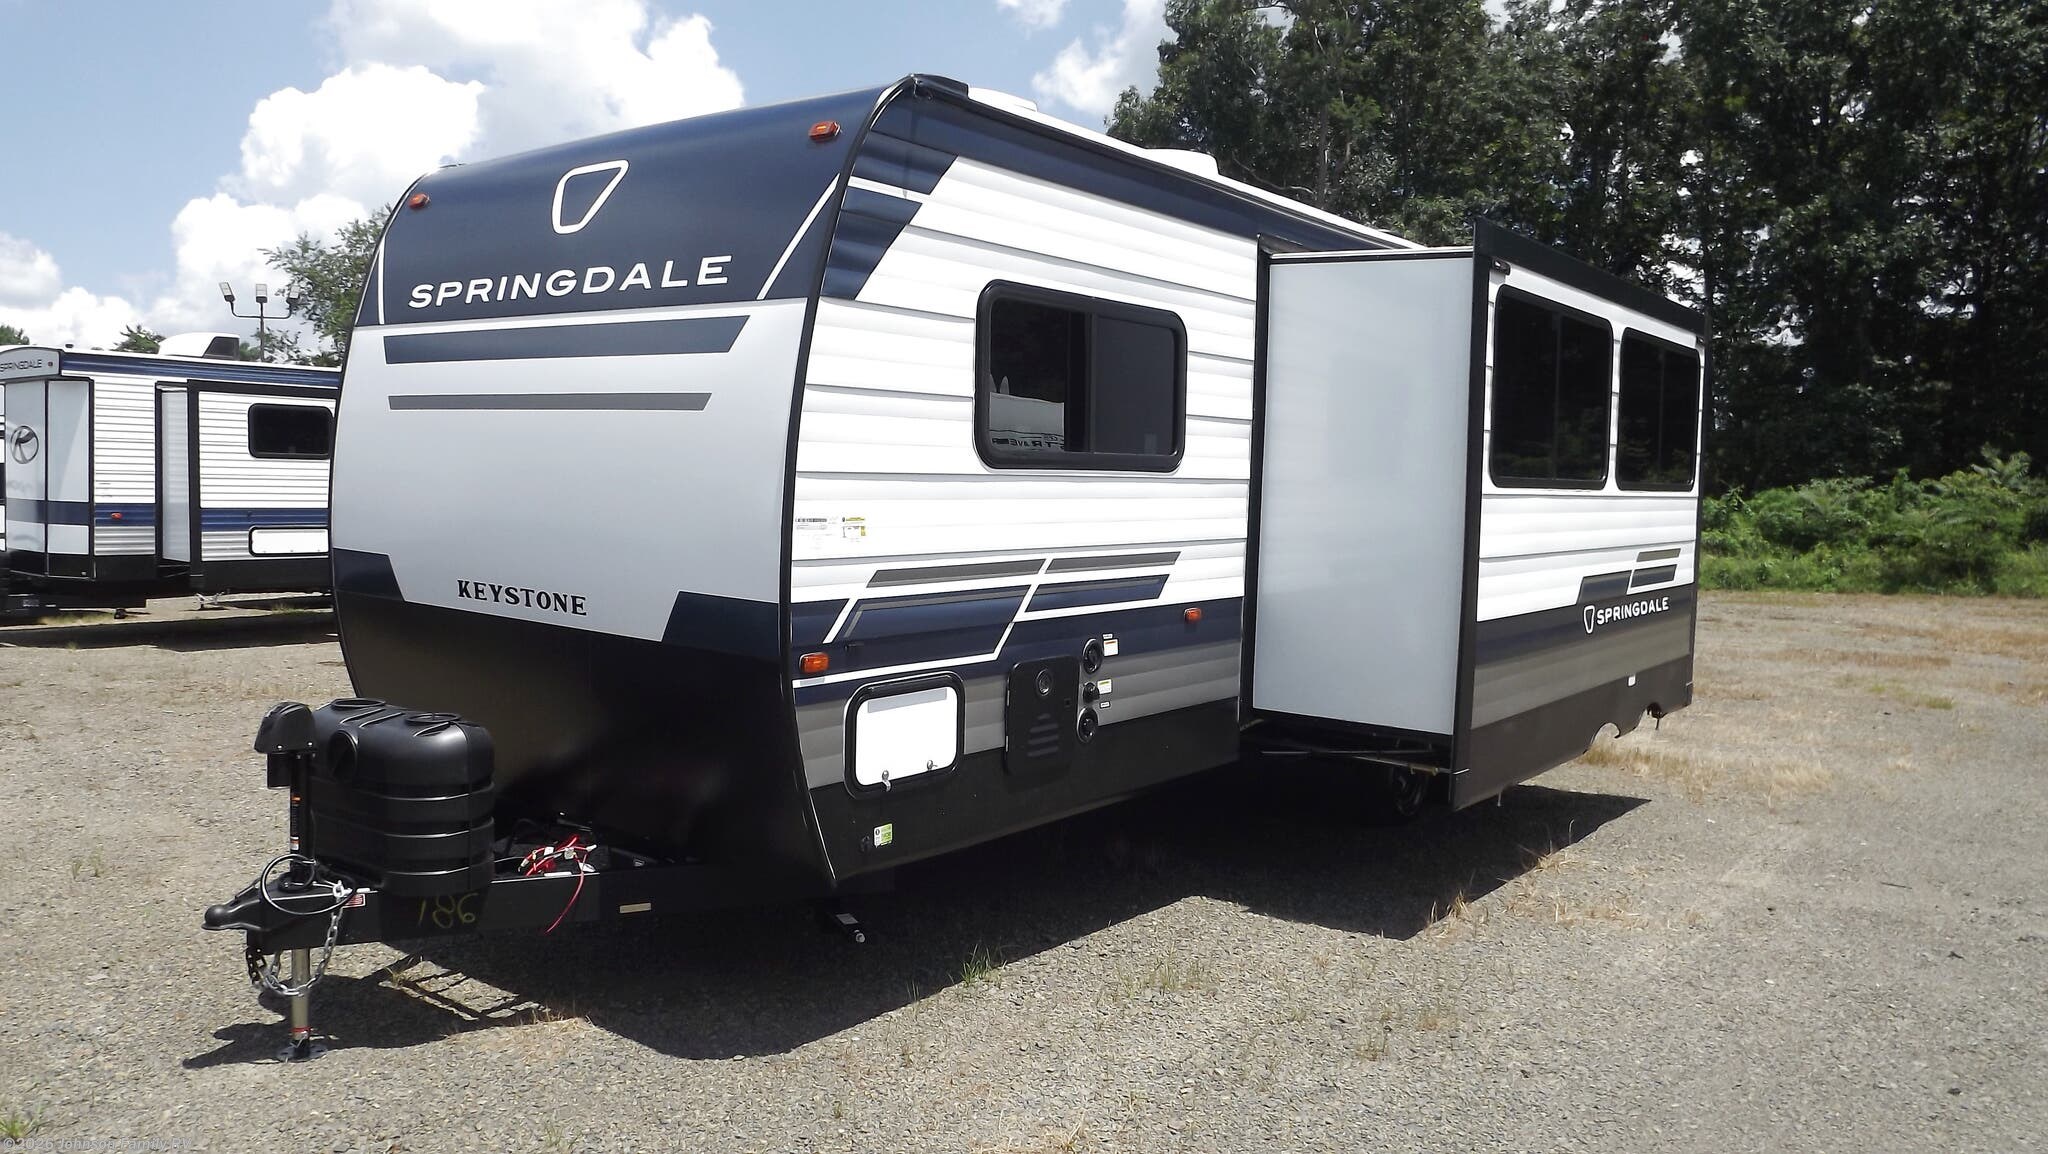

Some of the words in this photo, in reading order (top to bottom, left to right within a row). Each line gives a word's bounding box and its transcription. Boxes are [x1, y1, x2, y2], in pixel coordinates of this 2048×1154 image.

[408, 255, 732, 309] SPRINGDALE
[457, 579, 587, 616] KEYSTONE
[1596, 596, 1669, 625] SPRINGDALE
[416, 892, 480, 929] 186
